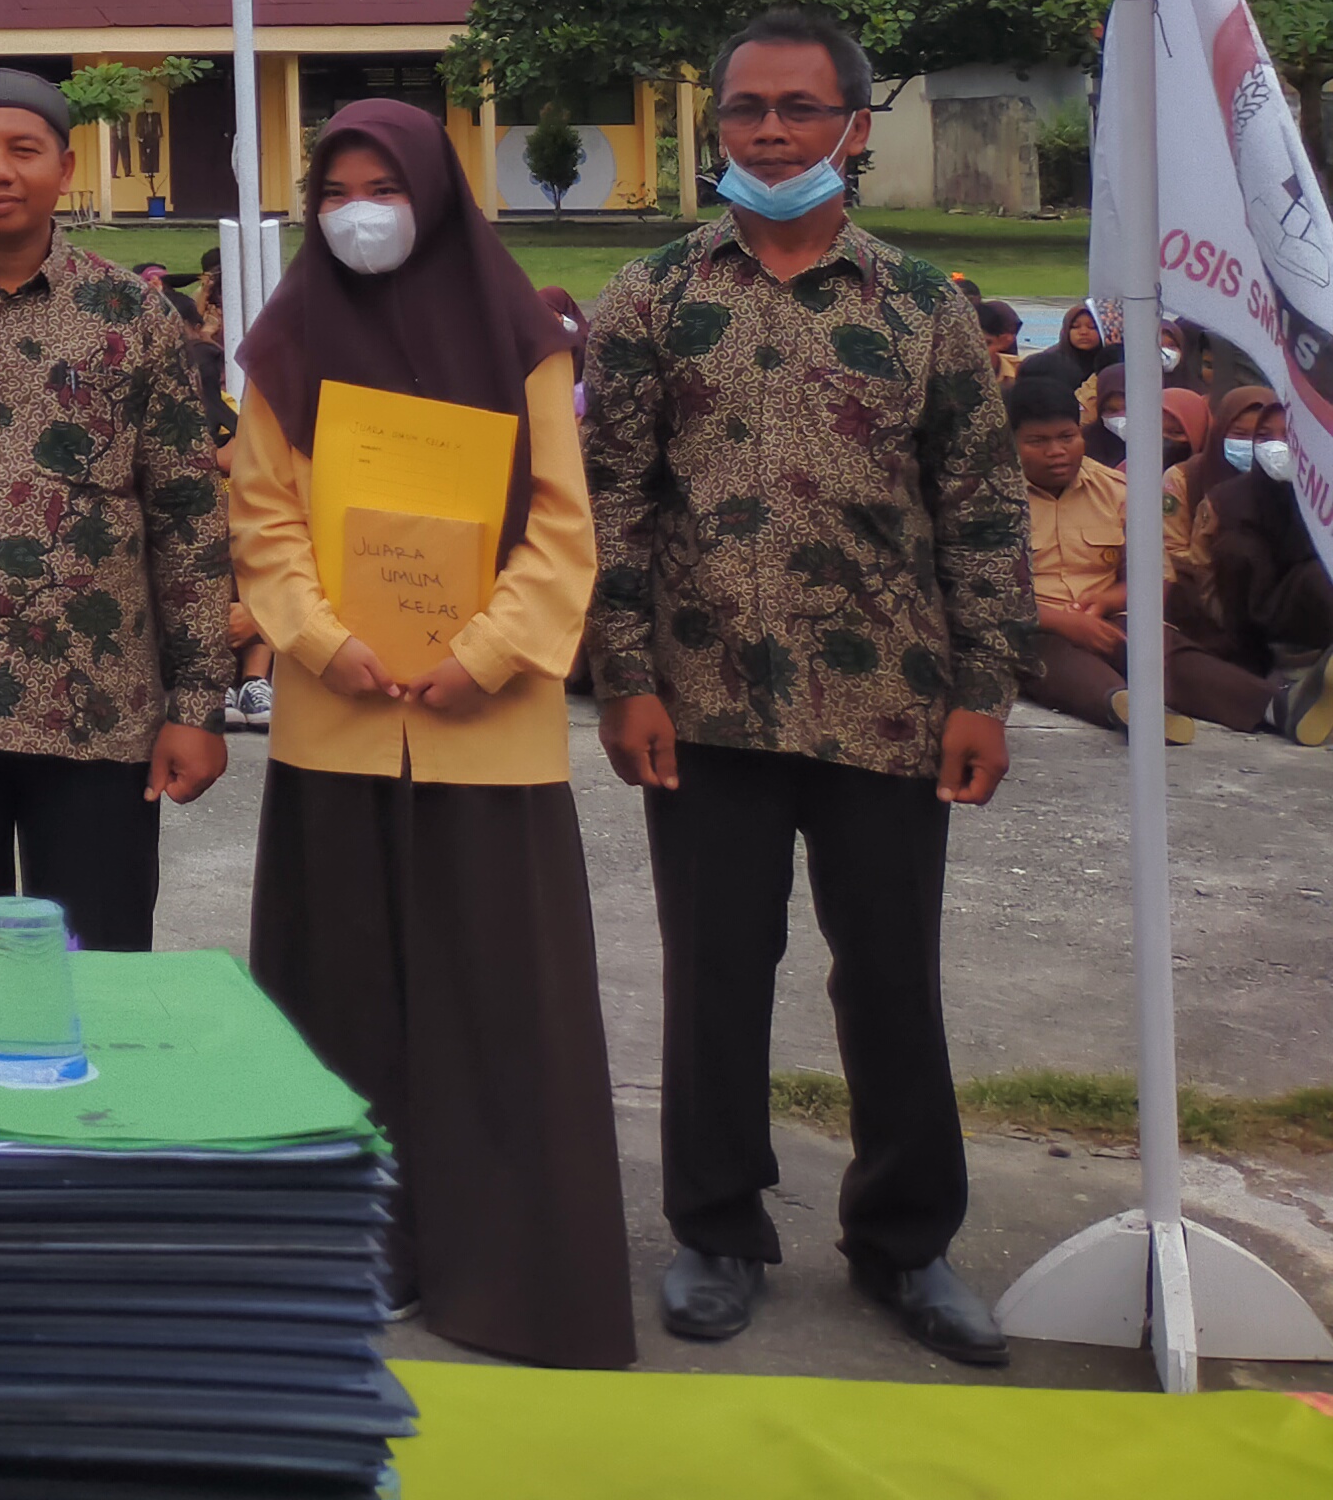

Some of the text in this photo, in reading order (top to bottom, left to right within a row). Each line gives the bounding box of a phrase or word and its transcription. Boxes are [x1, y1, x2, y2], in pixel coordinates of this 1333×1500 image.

[1160, 228, 1243, 298] OSIS
[353, 536, 425, 560] JUARA
[381, 567, 444, 589] UMUM
[397, 594, 460, 621] KELAS
[425, 629, 443, 647] X
